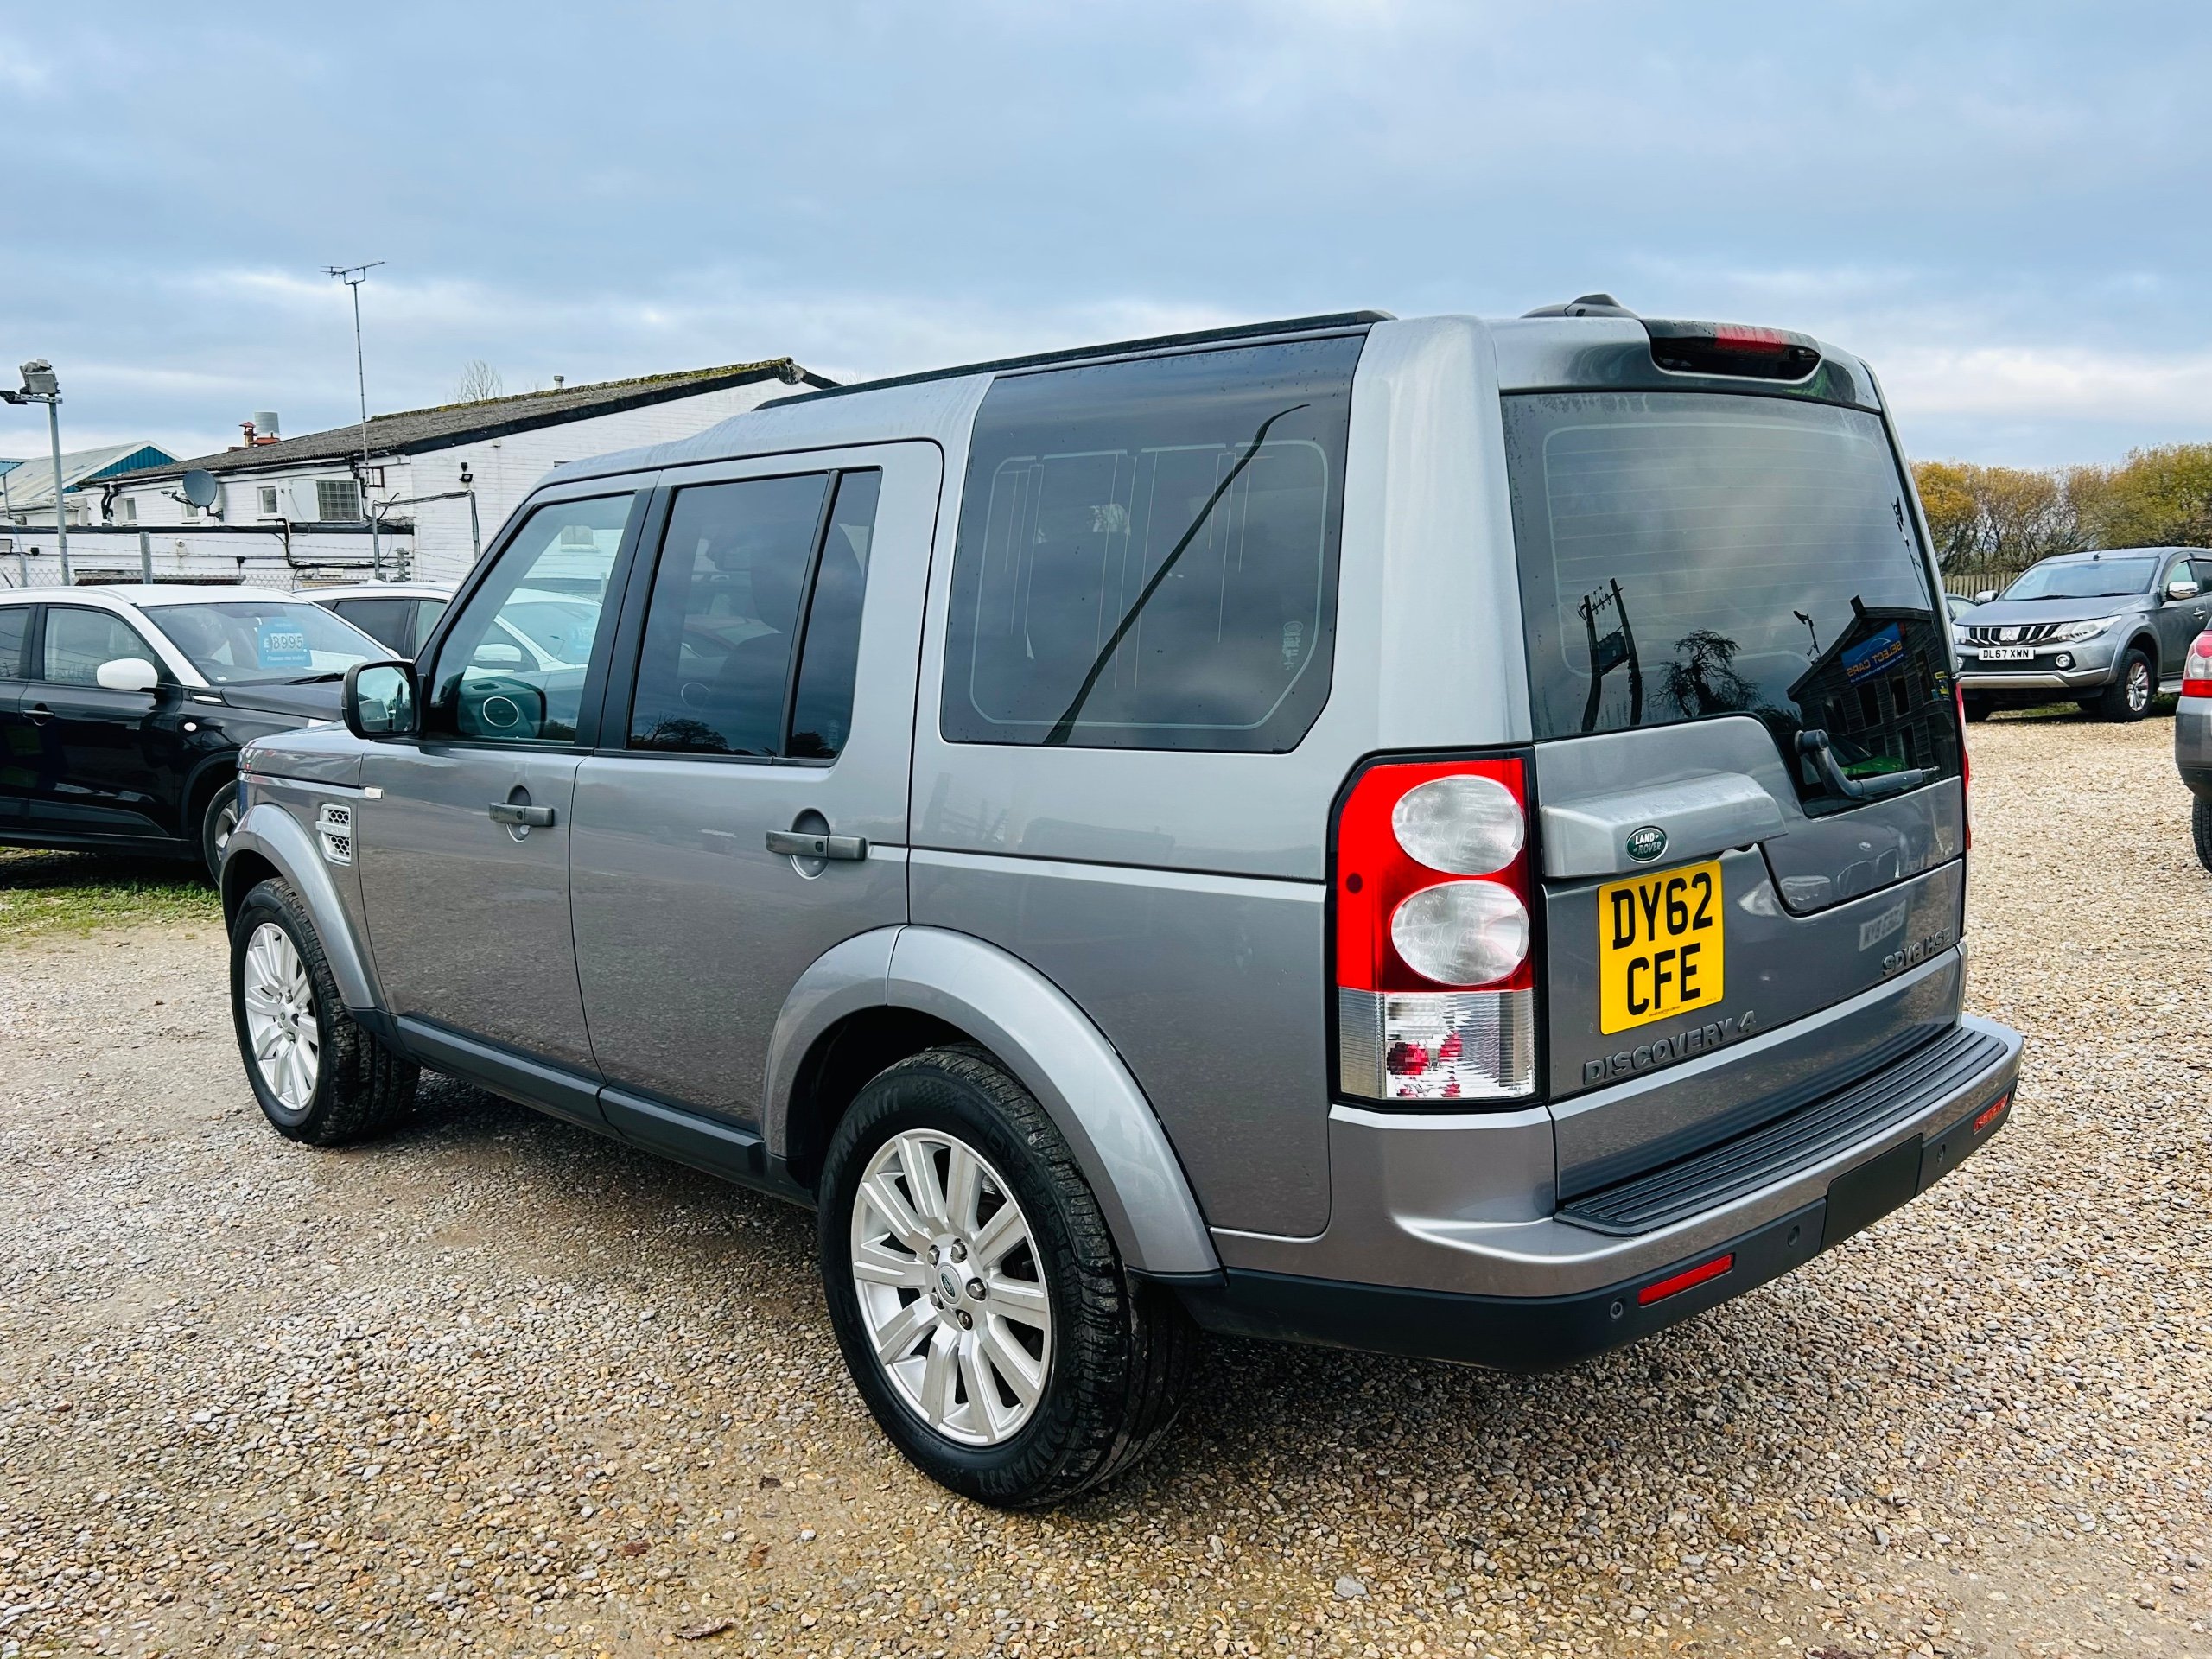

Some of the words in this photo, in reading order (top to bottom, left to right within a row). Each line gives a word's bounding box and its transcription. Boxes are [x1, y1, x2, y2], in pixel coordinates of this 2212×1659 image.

[1982, 649, 2007, 658] DL67
[2010, 649, 2029, 658] XWN
[1635, 832, 1655, 845] LAND
[1637, 841, 1662, 855] ROVER
[1611, 871, 1713, 950] DY62
[1923, 926, 1950, 957] HSE
[1627, 942, 1701, 1016] CFE
[1583, 1017, 1733, 1085] DISCOVERY
[1738, 1010, 1757, 1033] 4
